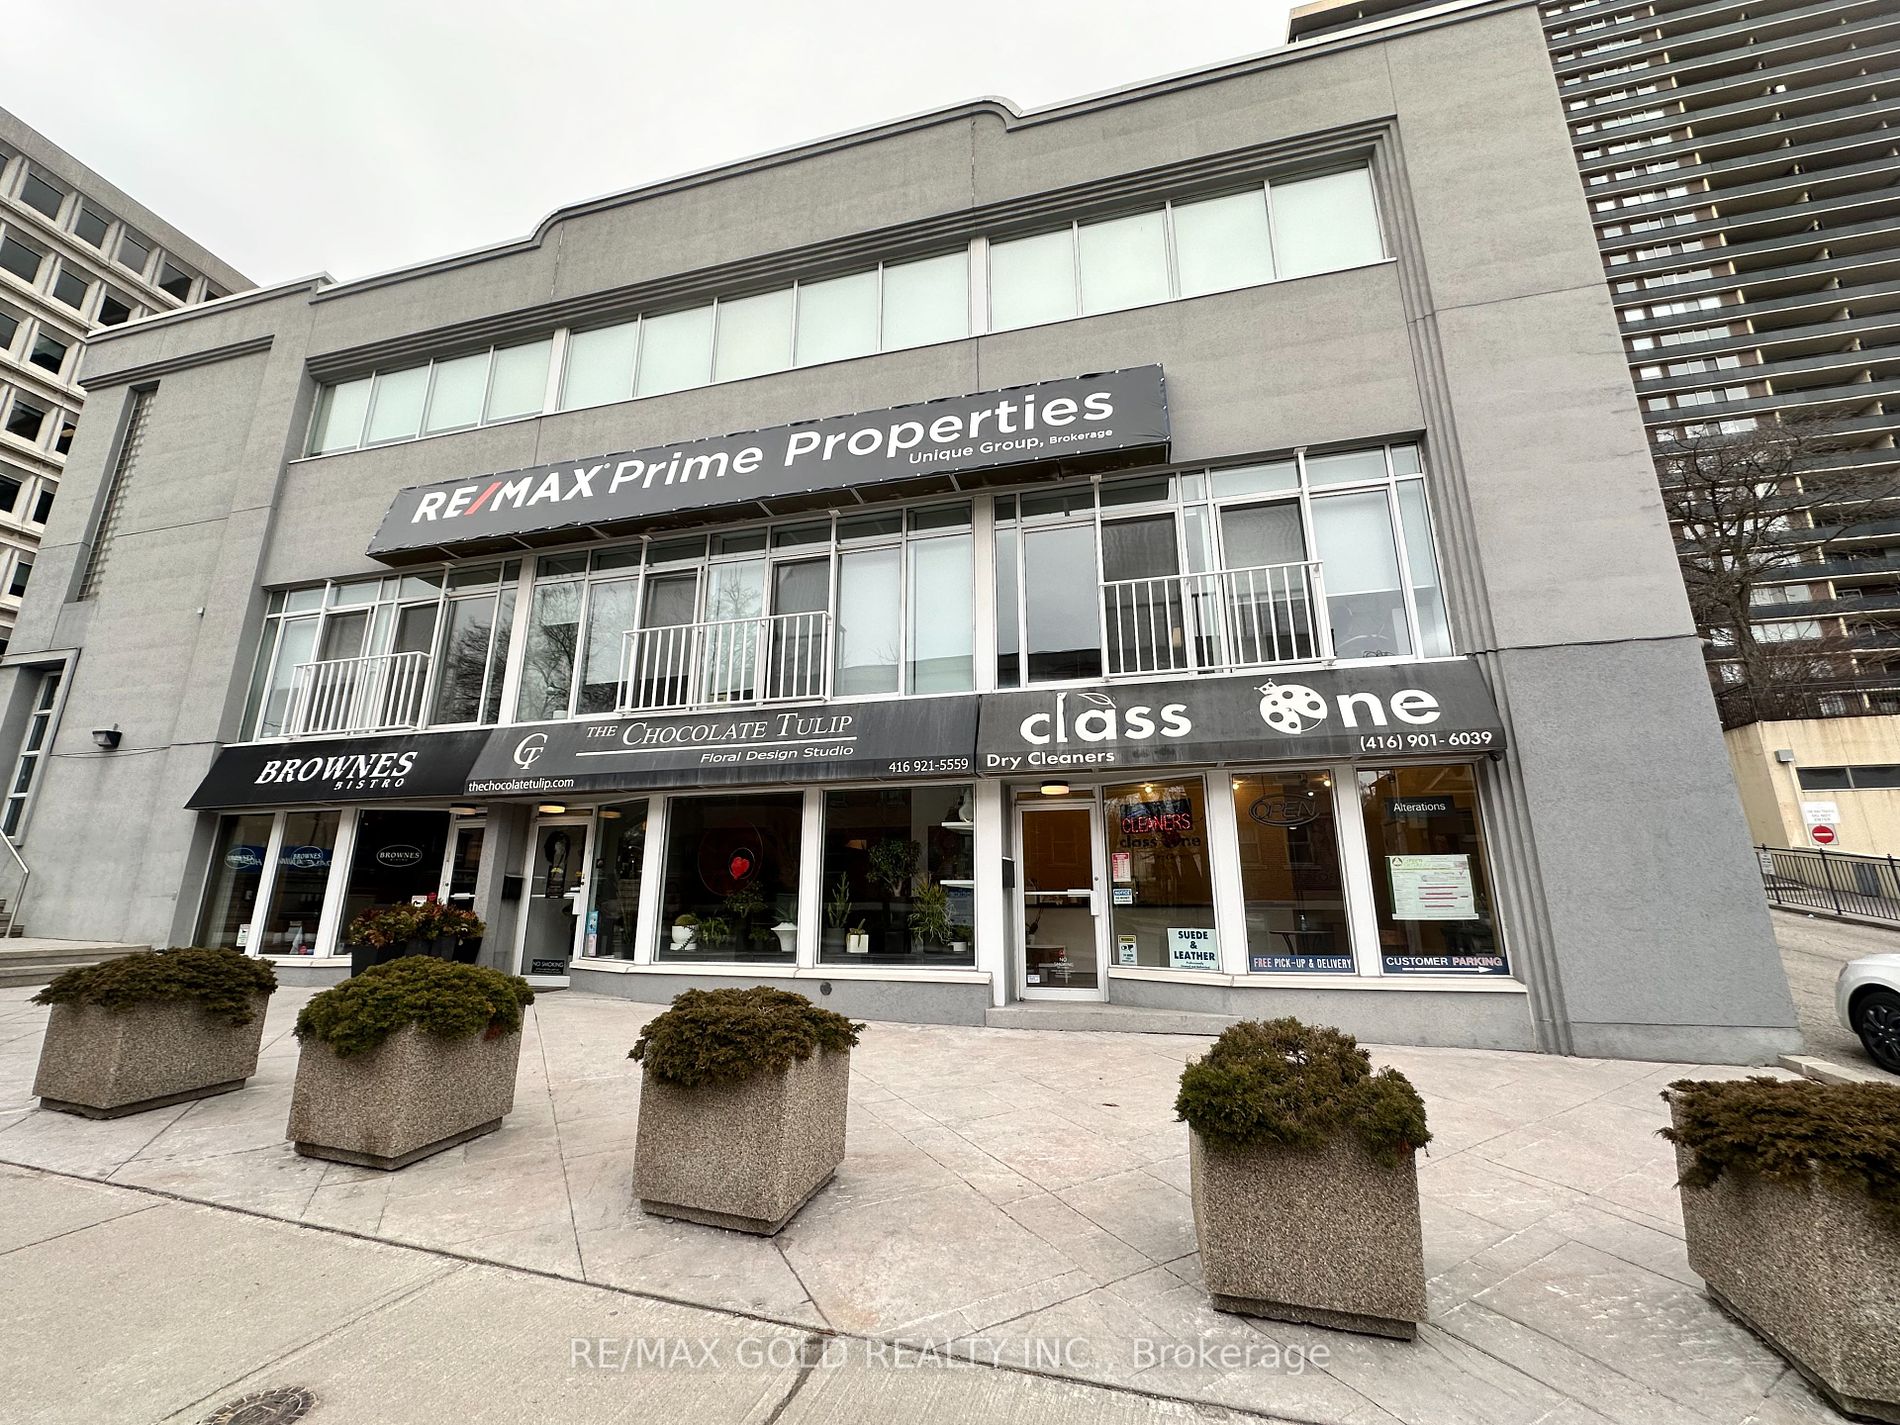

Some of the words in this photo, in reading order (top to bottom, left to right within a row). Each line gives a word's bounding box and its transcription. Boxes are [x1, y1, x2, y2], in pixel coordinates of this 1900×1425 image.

[909, 445, 974, 464] Unique
[979, 436, 1044, 456] Group,
[1049, 429, 1114, 445] Brokerage
[411, 464, 603, 524] RE/MAX
[608, 446, 764, 494] Prime
[783, 392, 1114, 467] Properties
[1019, 692, 1192, 745] class
[586, 725, 618, 738] THE
[1360, 733, 1403, 751] (416)
[700, 751, 742, 763] Floral
[746, 748, 798, 761] Design
[803, 745, 854, 758] Studio
[986, 754, 1022, 770] Dry
[1027, 751, 1115, 765] Cleaners
[254, 751, 418, 785] BROWNES
[888, 761, 910, 773] 416
[913, 758, 969, 772] 921-5559
[333, 777, 405, 791] BISTRO
[468, 777, 574, 793] thechocolatetulip.com
[1250, 798, 1316, 820] OPEN
[1393, 802, 1446, 812] Alterations
[1122, 813, 1191, 834] CLEANERS
[292, 852, 322, 861] BROWNES
[379, 851, 420, 859] BROWNES
[1178, 930, 1208, 940] SUEDE
[1189, 940, 1198, 949] &
[1174, 951, 1215, 961] LEATHER
[1253, 957, 1272, 968] FREE
[1274, 958, 1305, 968] PICK-UP
[1308, 959, 1315, 968] &
[1317, 958, 1351, 969] DELIVERY
[1386, 957, 1448, 966] CUSTOMER
[1452, 957, 1503, 966] PARKING
